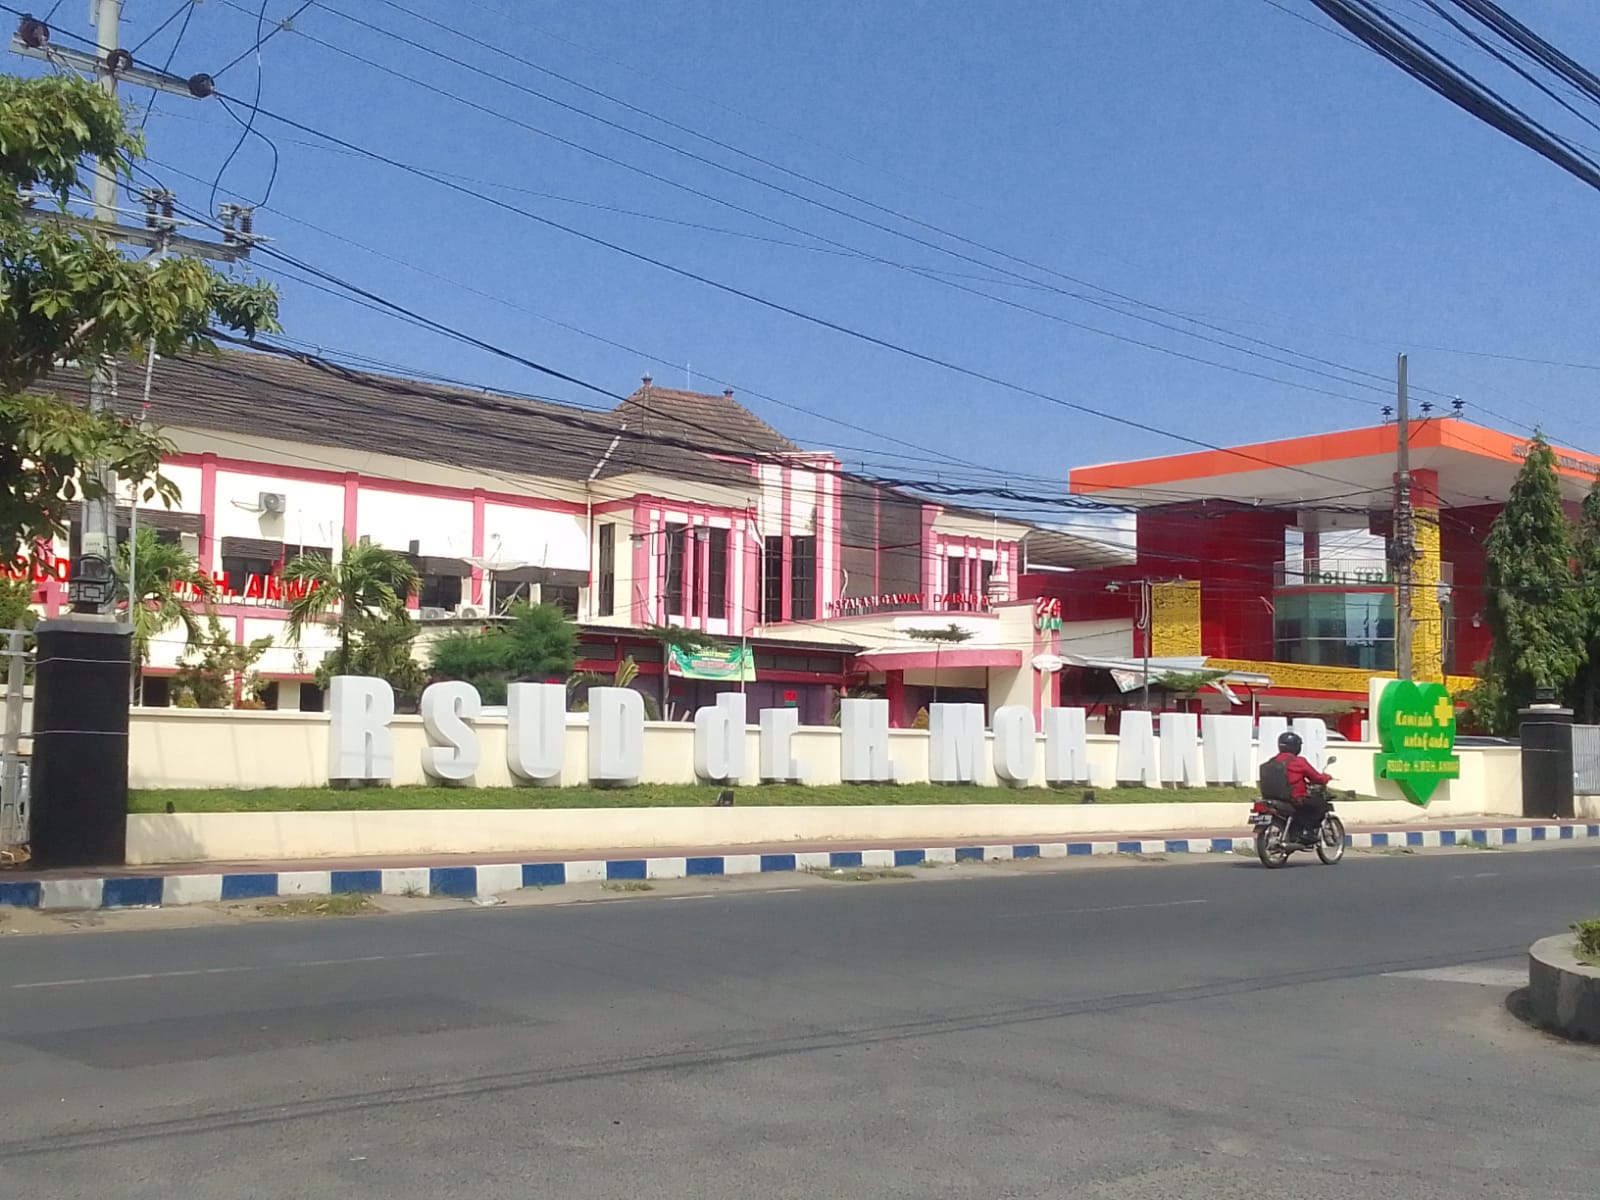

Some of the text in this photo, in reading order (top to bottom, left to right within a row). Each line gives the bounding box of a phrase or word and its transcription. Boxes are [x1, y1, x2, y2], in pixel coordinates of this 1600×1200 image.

[244, 573, 339, 606] ANWA
[1036, 596, 1062, 616] 24
[1034, 616, 1063, 631] JAM
[329, 675, 645, 780] RSUD
[694, 692, 811, 780] dr.
[841, 698, 902, 782] H.
[928, 703, 1096, 786] MOH.
